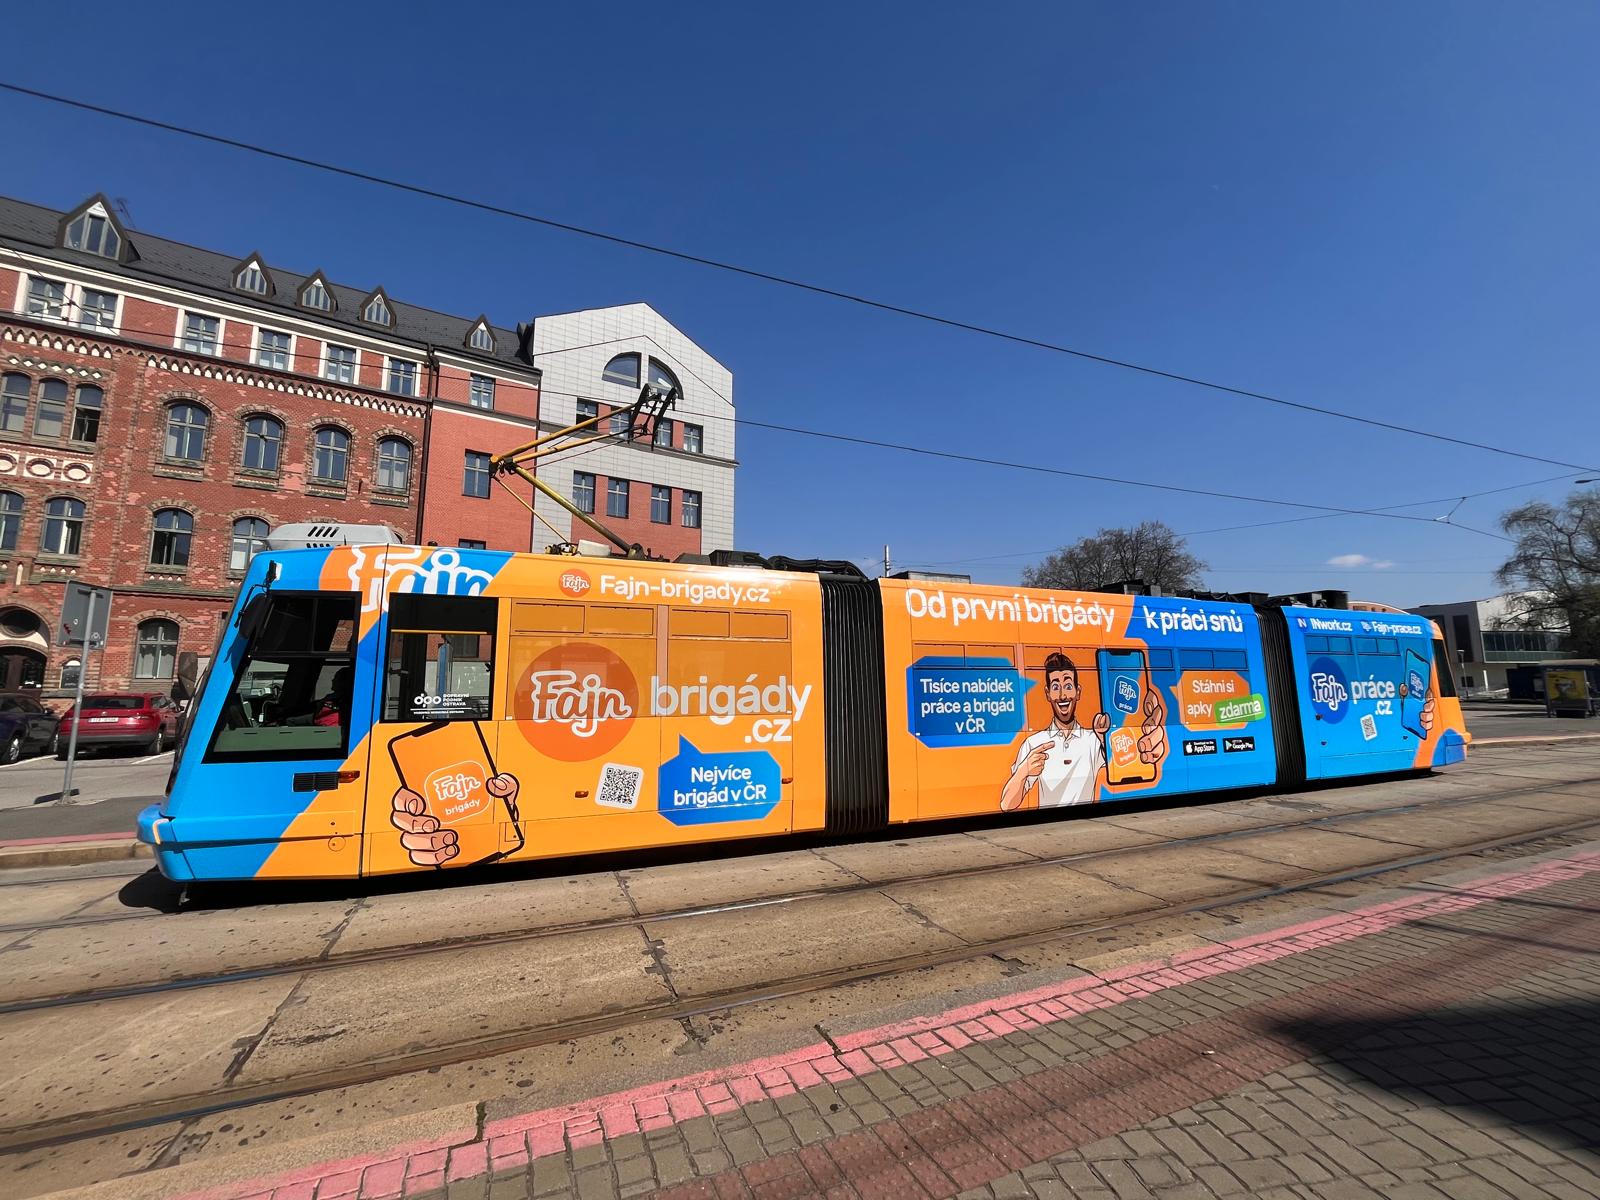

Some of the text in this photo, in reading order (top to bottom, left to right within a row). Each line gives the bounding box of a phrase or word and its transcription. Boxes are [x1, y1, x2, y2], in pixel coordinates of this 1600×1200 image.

[562, 574, 590, 592] Fajn
[600, 574, 771, 605] Fajn-brigady.cz
[905, 588, 1115, 633] Od první brigády
[1142, 604, 1159, 629] k
[1160, 606, 1208, 635] práci
[1372, 621, 1423, 635] Fajn-prace.cz
[920, 677, 1014, 694] Tisíce nabídek
[1118, 680, 1137, 701] Fajn
[1192, 679, 1235, 694] Stáhni si
[1312, 672, 1348, 711] Fajn
[1351, 674, 1396, 704] práce
[531, 670, 633, 737] Fajn
[651, 673, 812, 726] brigády
[921, 697, 1015, 717] práce a brigád
[1375, 700, 1393, 715] .cz
[1187, 700, 1262, 721] apky zdarma
[744, 718, 792, 743] .cz
[955, 714, 986, 733] v ČR
[1194, 744, 1215, 753] App Store
[690, 764, 752, 786] Nejvíce
[432, 773, 481, 801] Fajn
[673, 781, 767, 808] brigád v ČR
[445, 798, 480, 816] brigády
